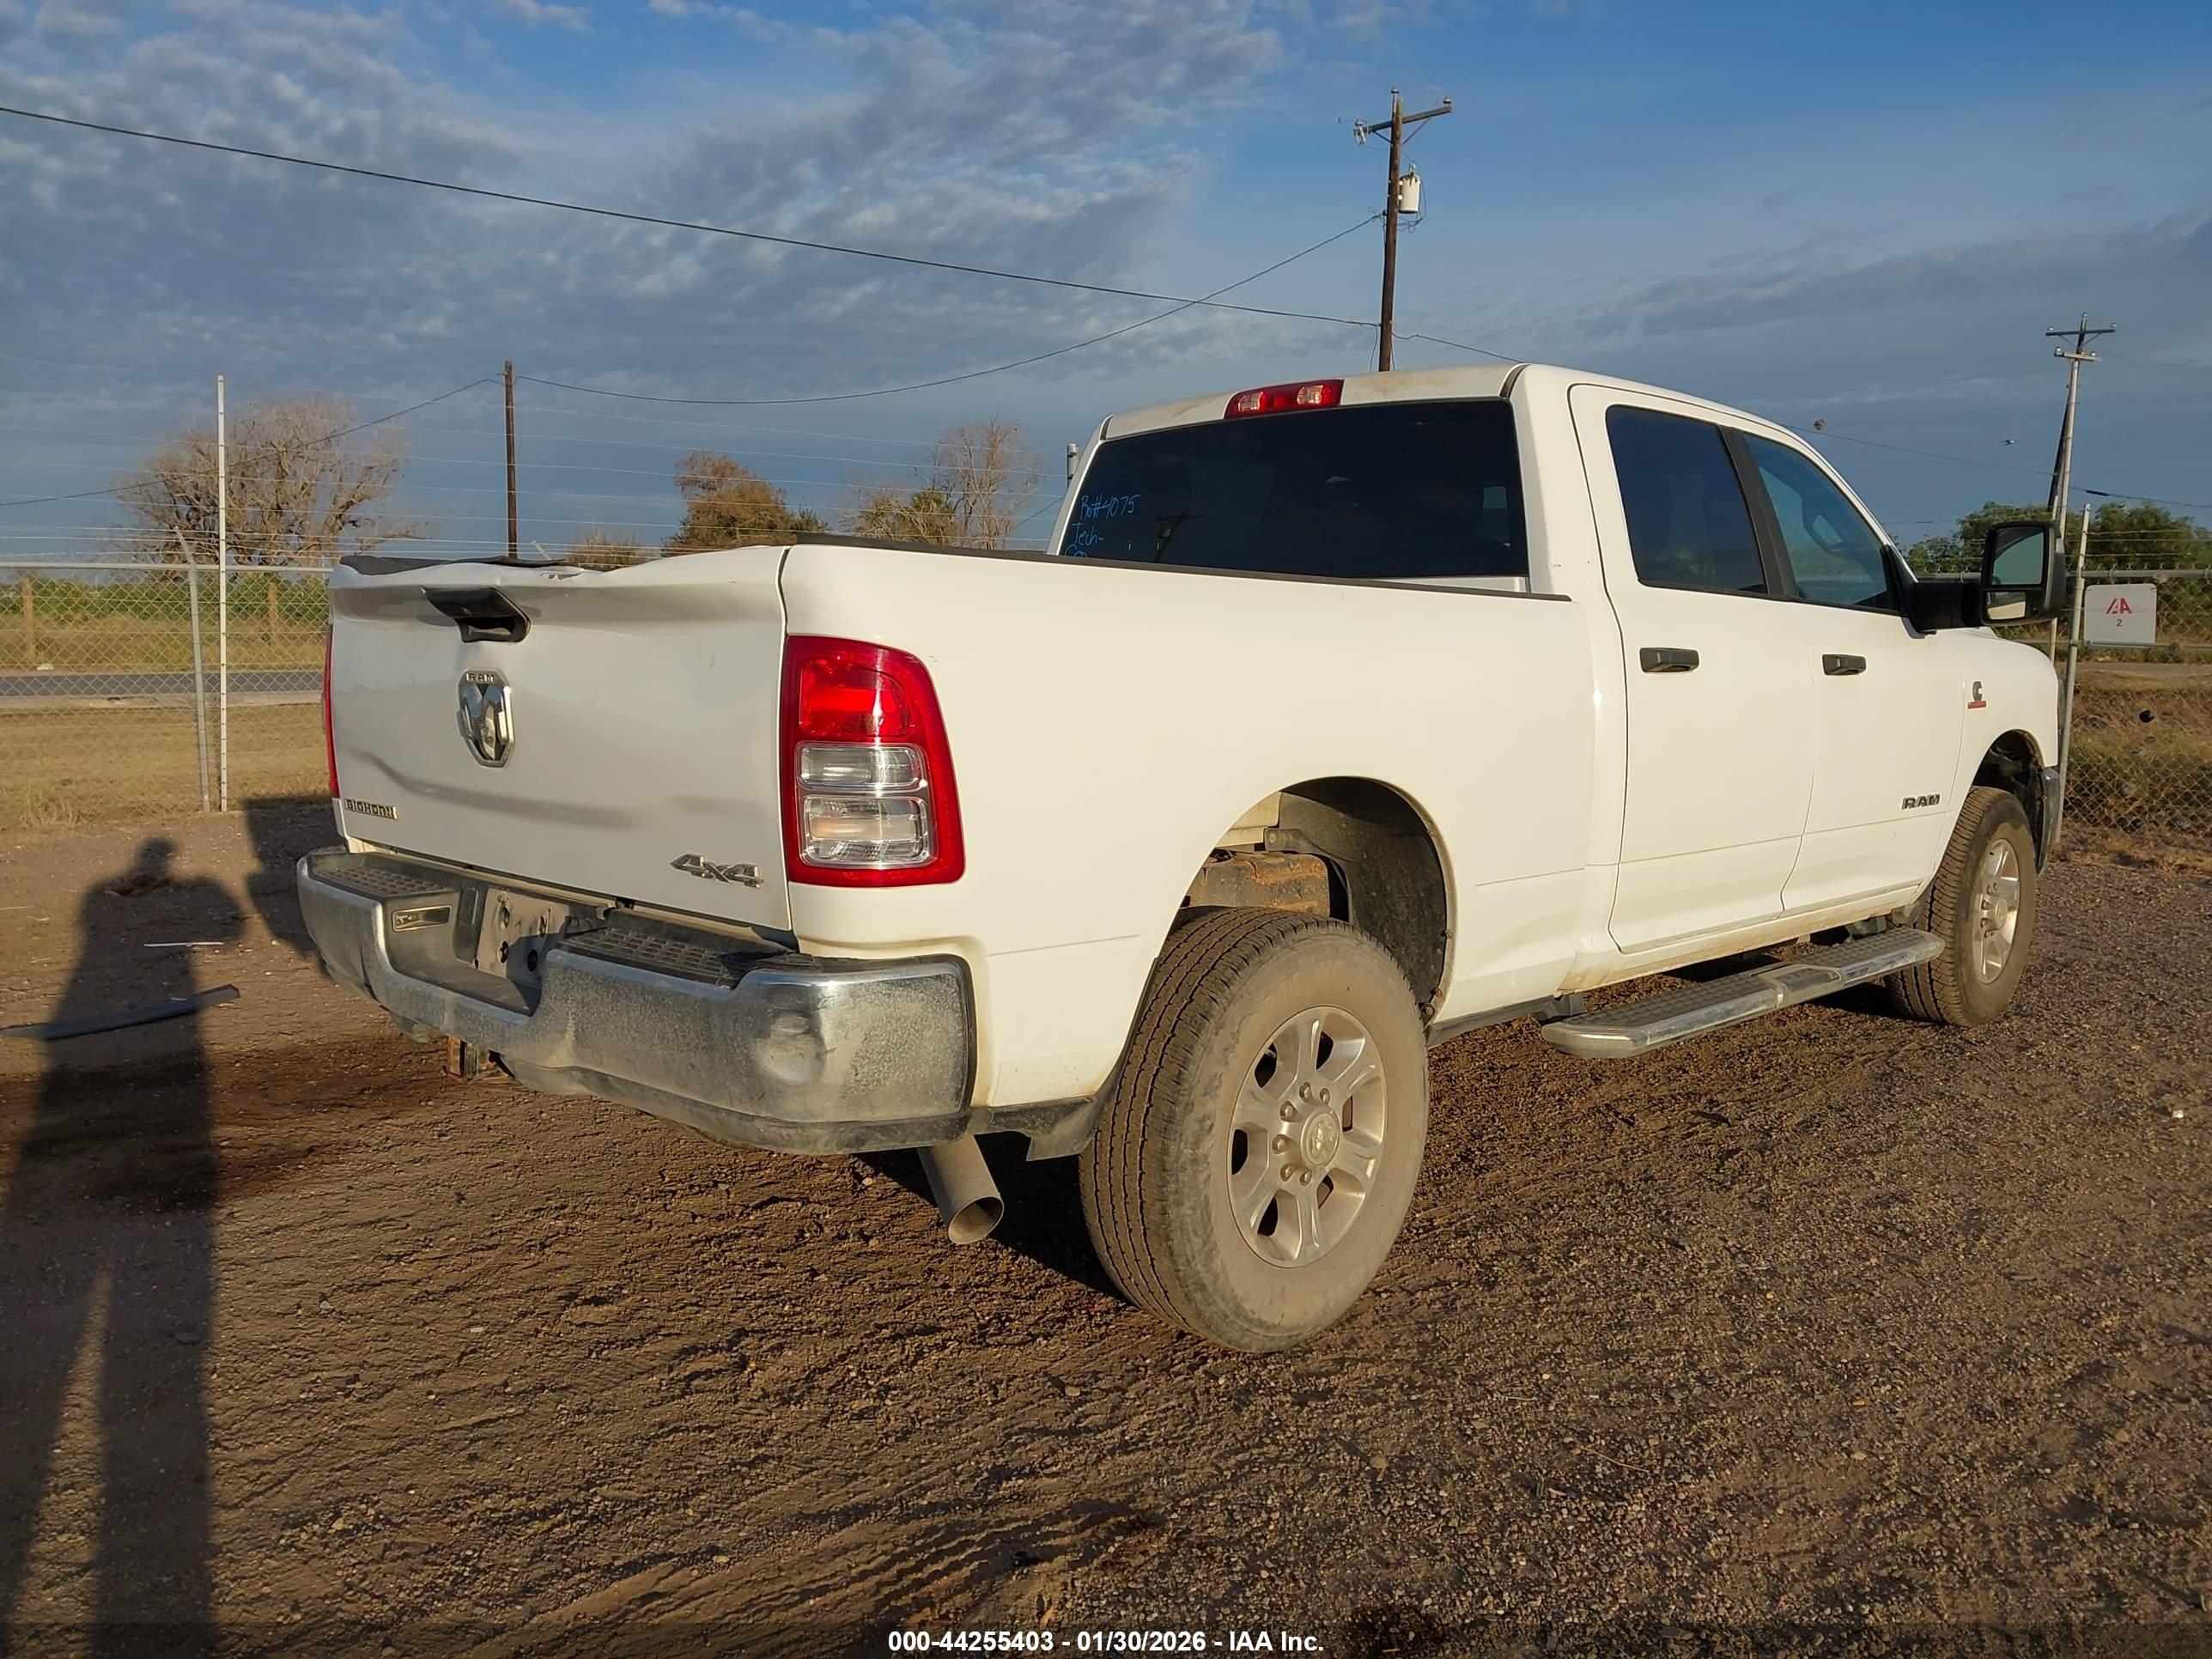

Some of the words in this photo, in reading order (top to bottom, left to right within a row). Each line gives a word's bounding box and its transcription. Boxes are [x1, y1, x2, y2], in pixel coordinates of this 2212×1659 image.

[2116, 618, 2123, 627] 2
[465, 672, 495, 684] RAM
[1901, 793, 1941, 810] RAM
[344, 798, 398, 820] BIGHORN
